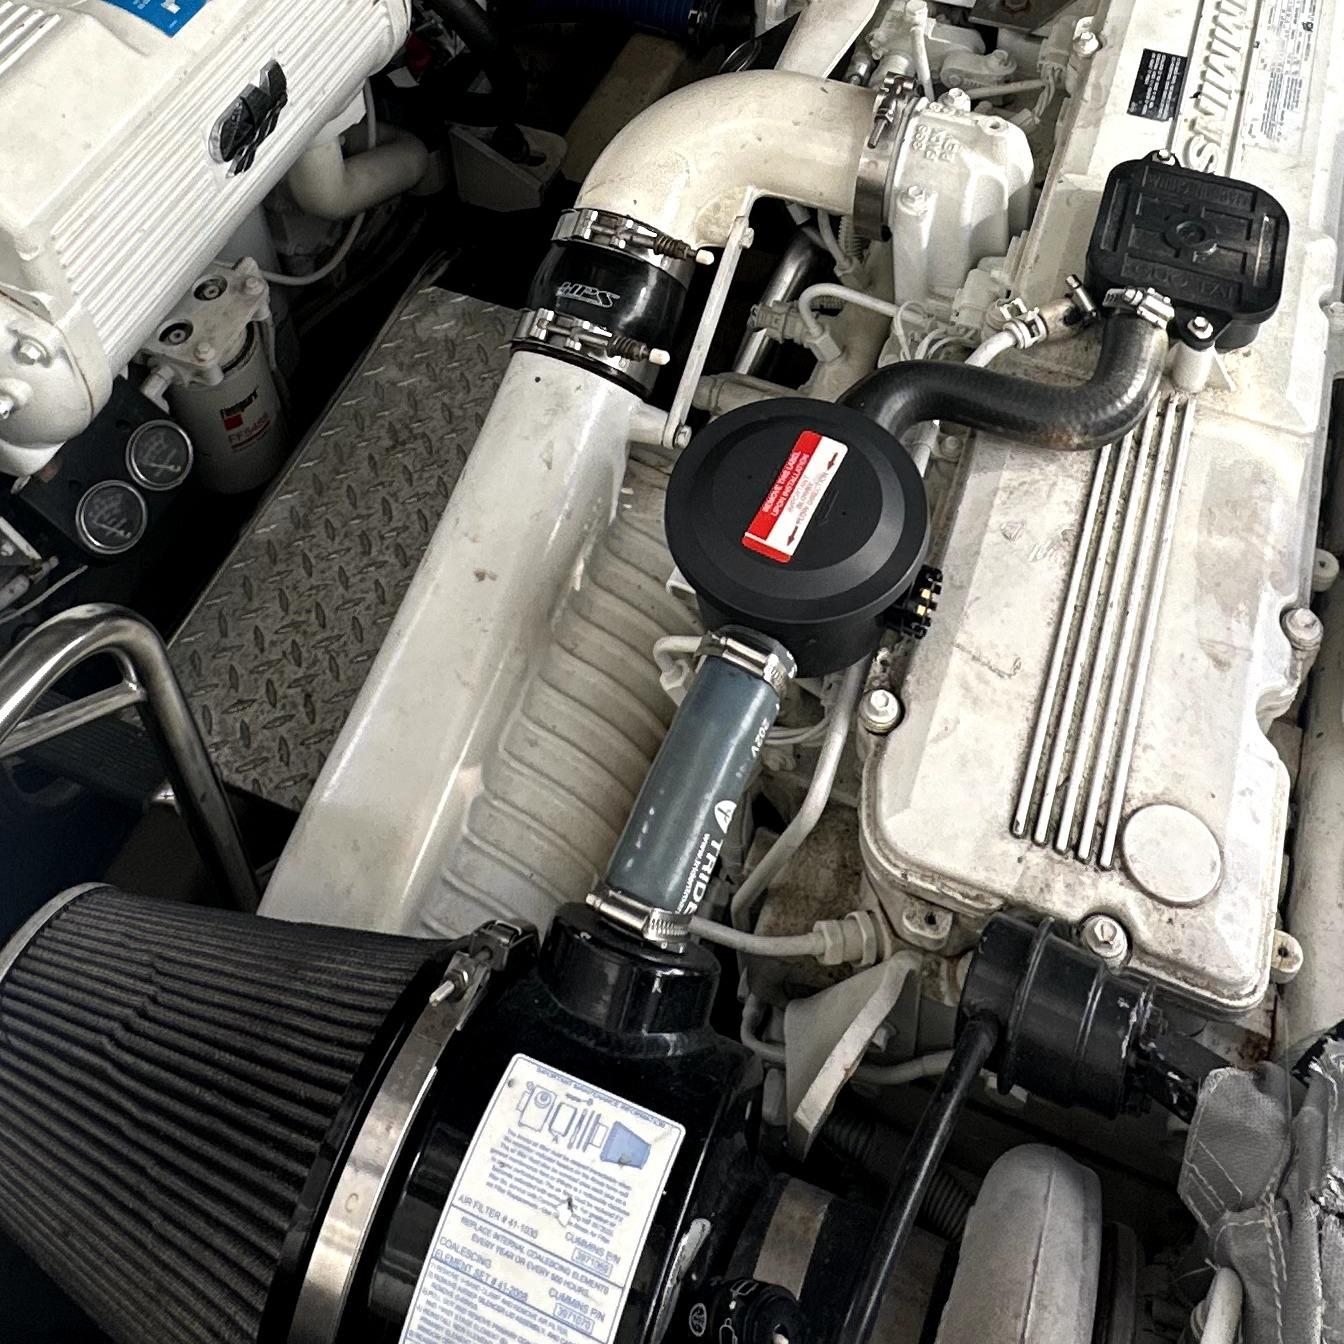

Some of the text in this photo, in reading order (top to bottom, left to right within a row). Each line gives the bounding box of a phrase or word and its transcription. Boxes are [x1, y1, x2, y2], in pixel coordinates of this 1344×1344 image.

[555, 281, 621, 308] HPS
[457, 1192, 473, 1206] AIR
[471, 1200, 501, 1220] FILTER
[438, 1235, 493, 1269] COALESCING
[470, 1233, 494, 1250] EVERY
[494, 1244, 514, 1260] YEAR
[513, 1254, 526, 1266] OR
[525, 1259, 550, 1278] EVERY
[563, 1230, 605, 1257] CUMMINS
[433, 1247, 473, 1274] ELEMENT
[472, 1267, 490, 1283] SET
[546, 1286, 590, 1315] CUMMINS
